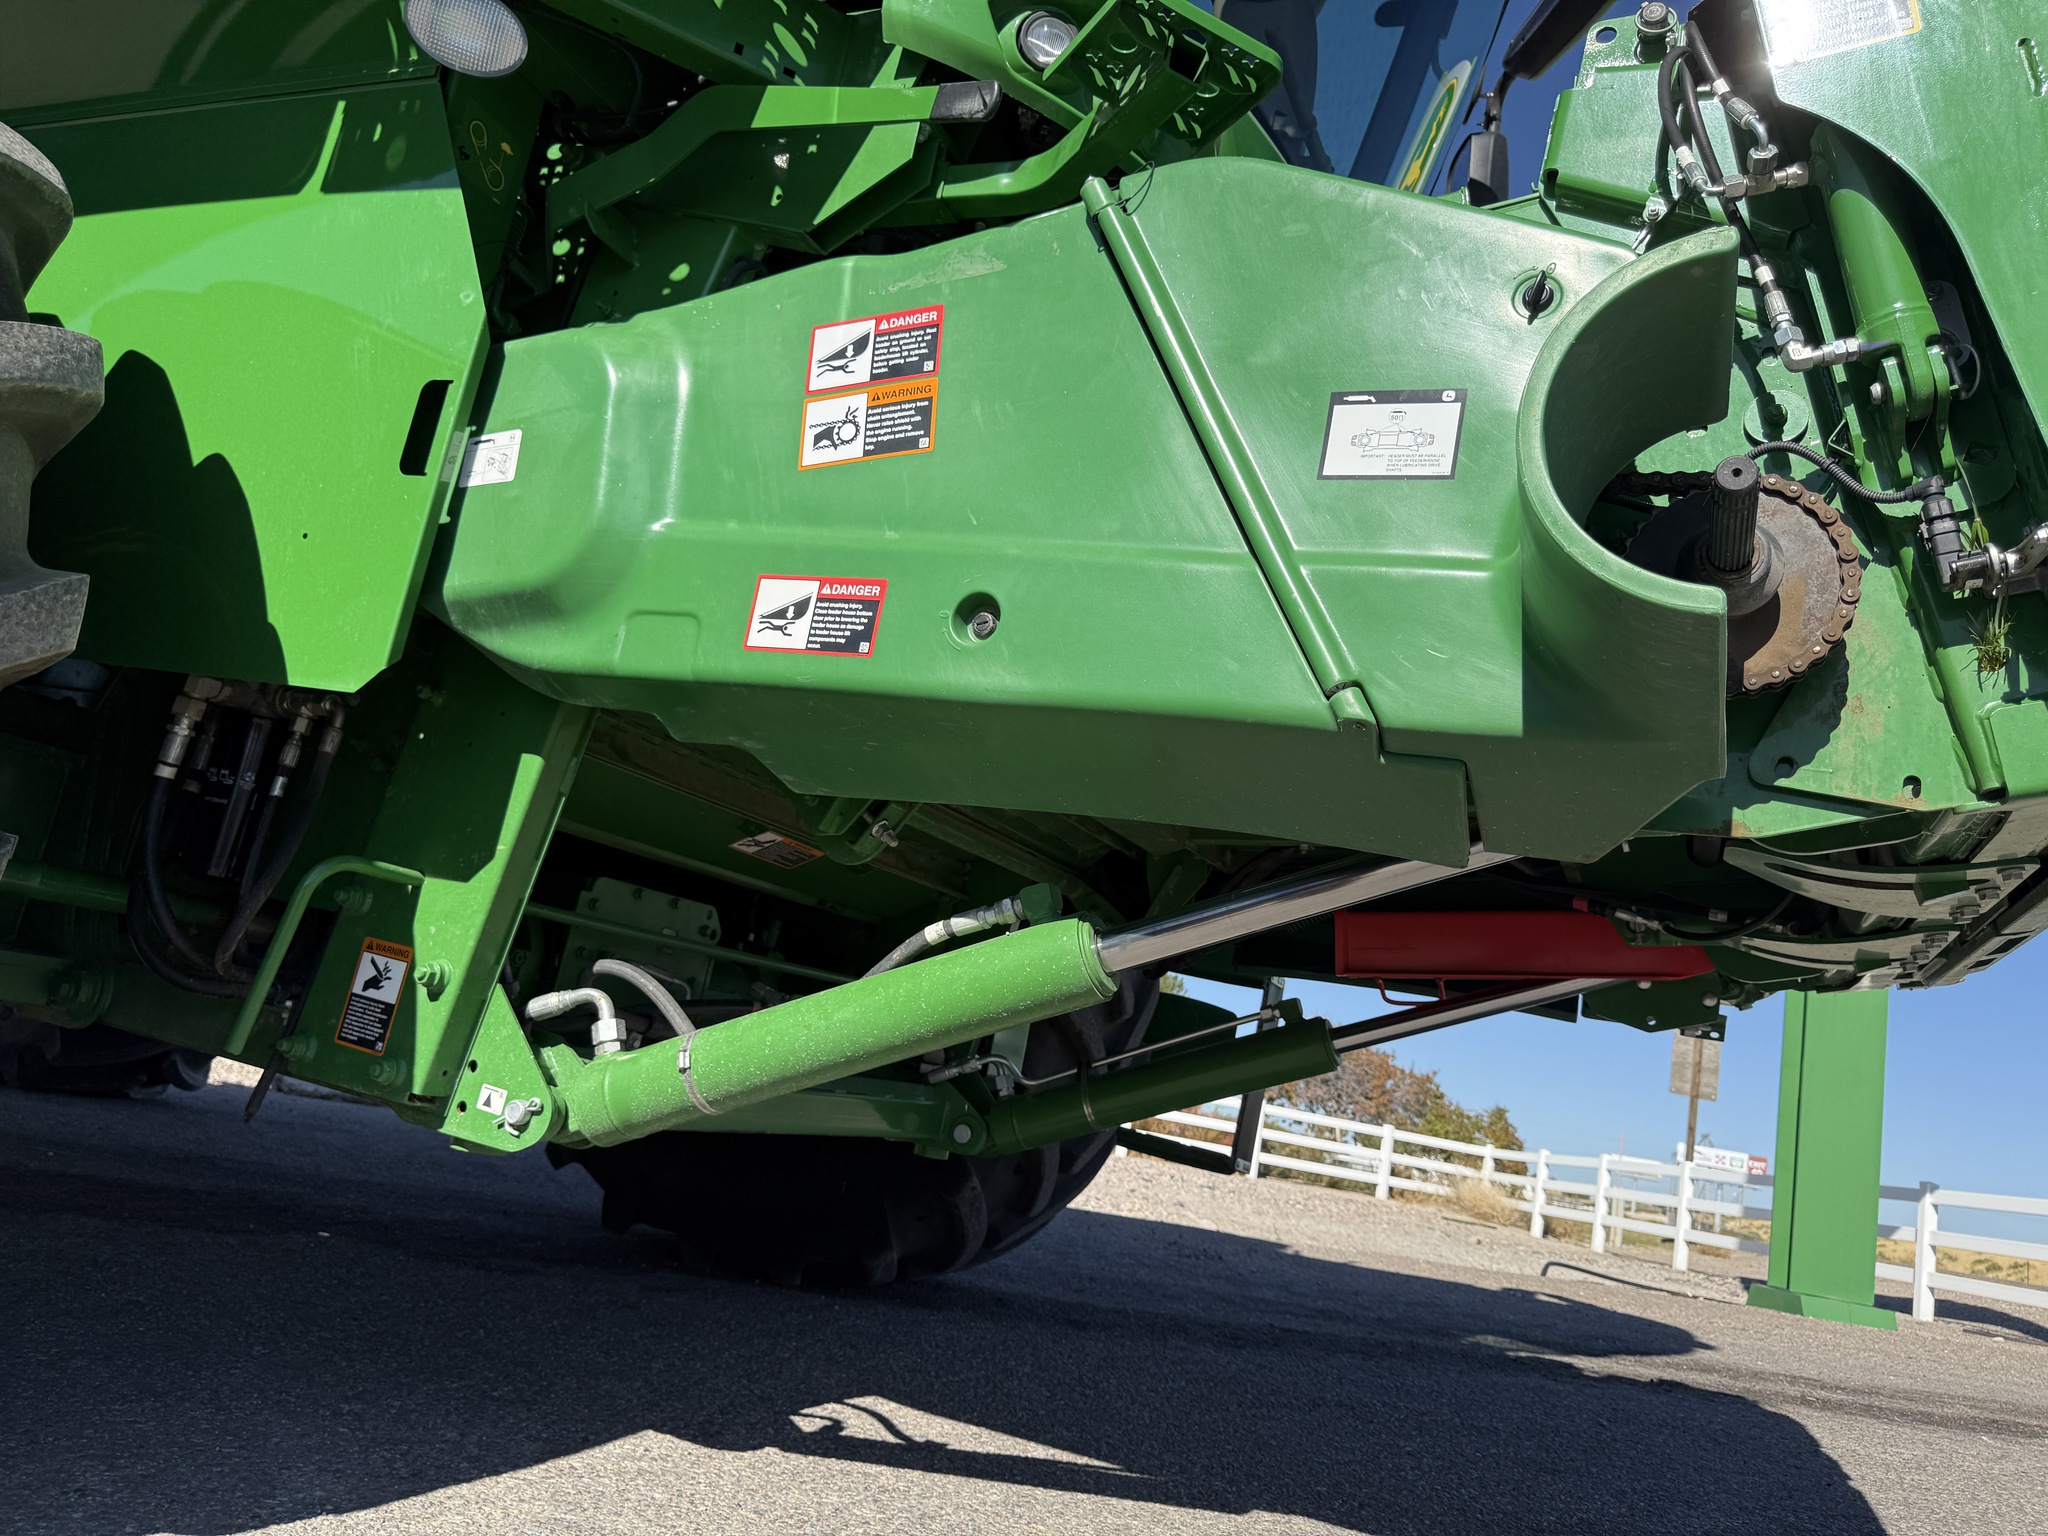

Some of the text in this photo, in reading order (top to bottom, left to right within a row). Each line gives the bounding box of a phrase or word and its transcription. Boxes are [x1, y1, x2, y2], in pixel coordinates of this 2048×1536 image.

[889, 311, 938, 328] DANGER
[882, 385, 932, 400] WARNING
[831, 585, 881, 596] DANGER
[375, 943, 410, 959] WARNING
